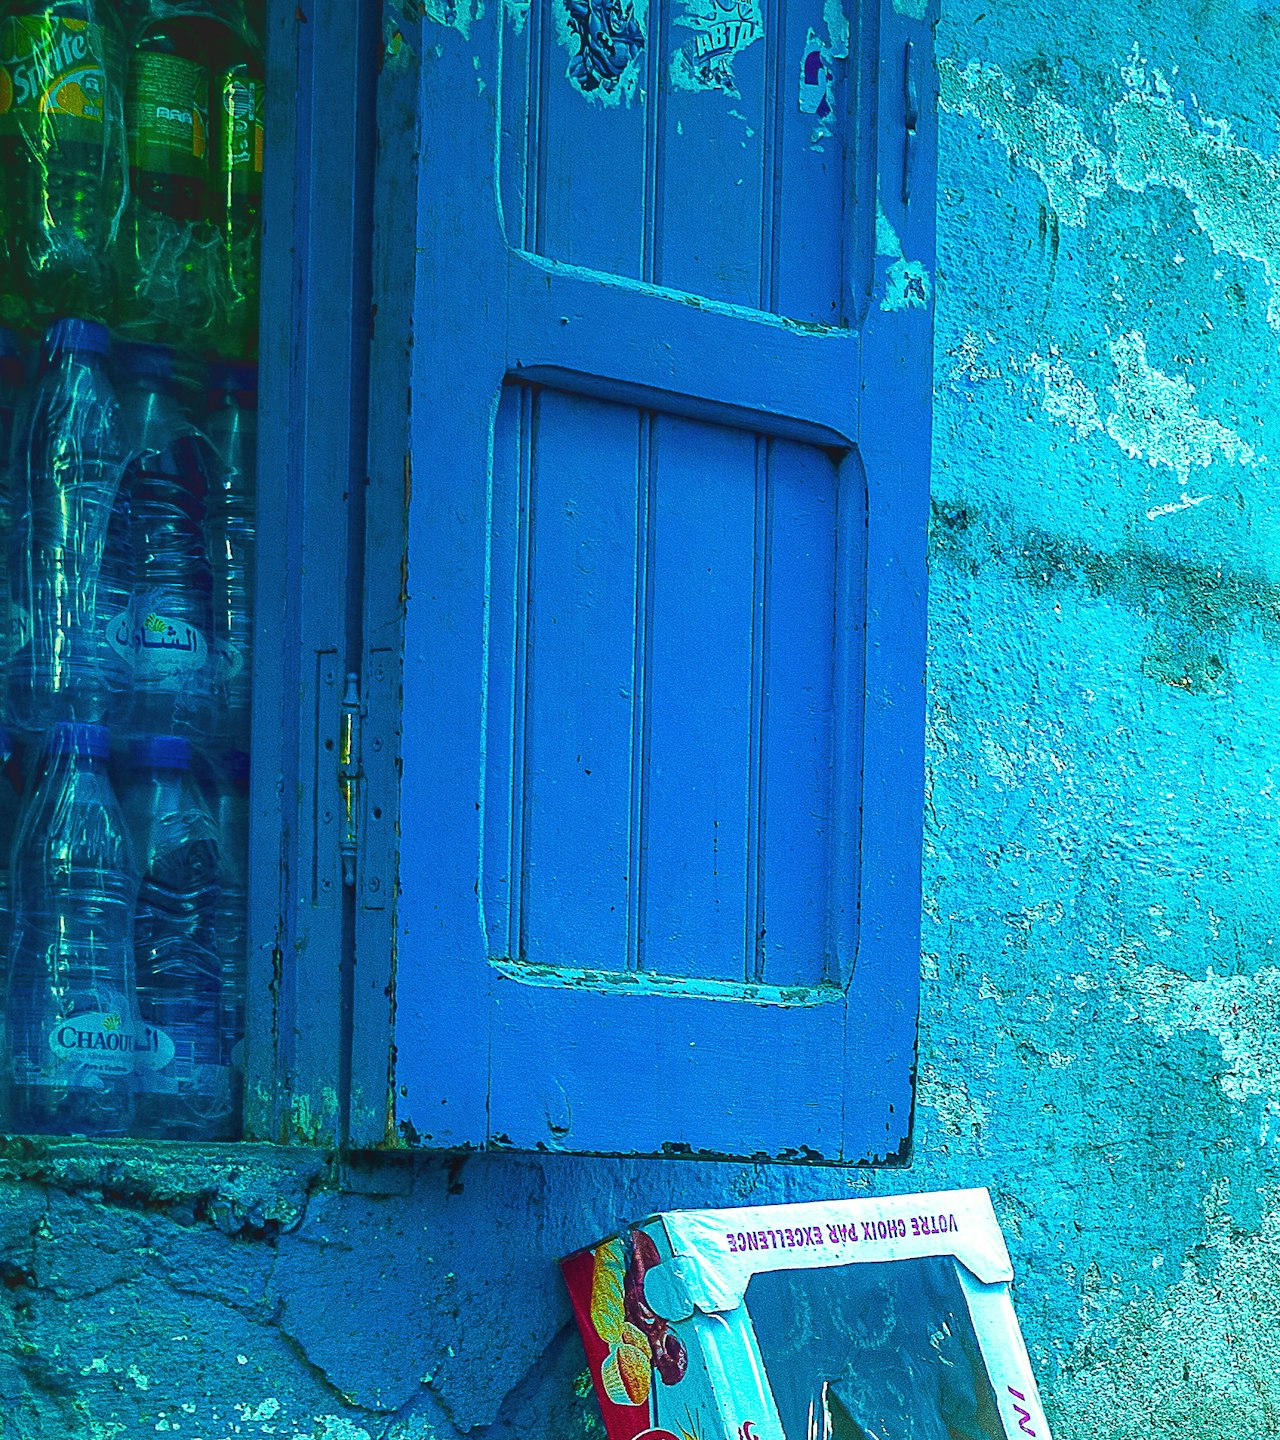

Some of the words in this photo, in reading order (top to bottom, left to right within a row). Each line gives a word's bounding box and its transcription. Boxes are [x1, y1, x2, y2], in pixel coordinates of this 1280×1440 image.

[13, 17, 91, 104] Sprite
[826, 1223, 858, 1244] PAR
[862, 1219, 906, 1241] CHOIX
[911, 1213, 958, 1236] VOTRE
[727, 1226, 824, 1252] EXCELLENCE
